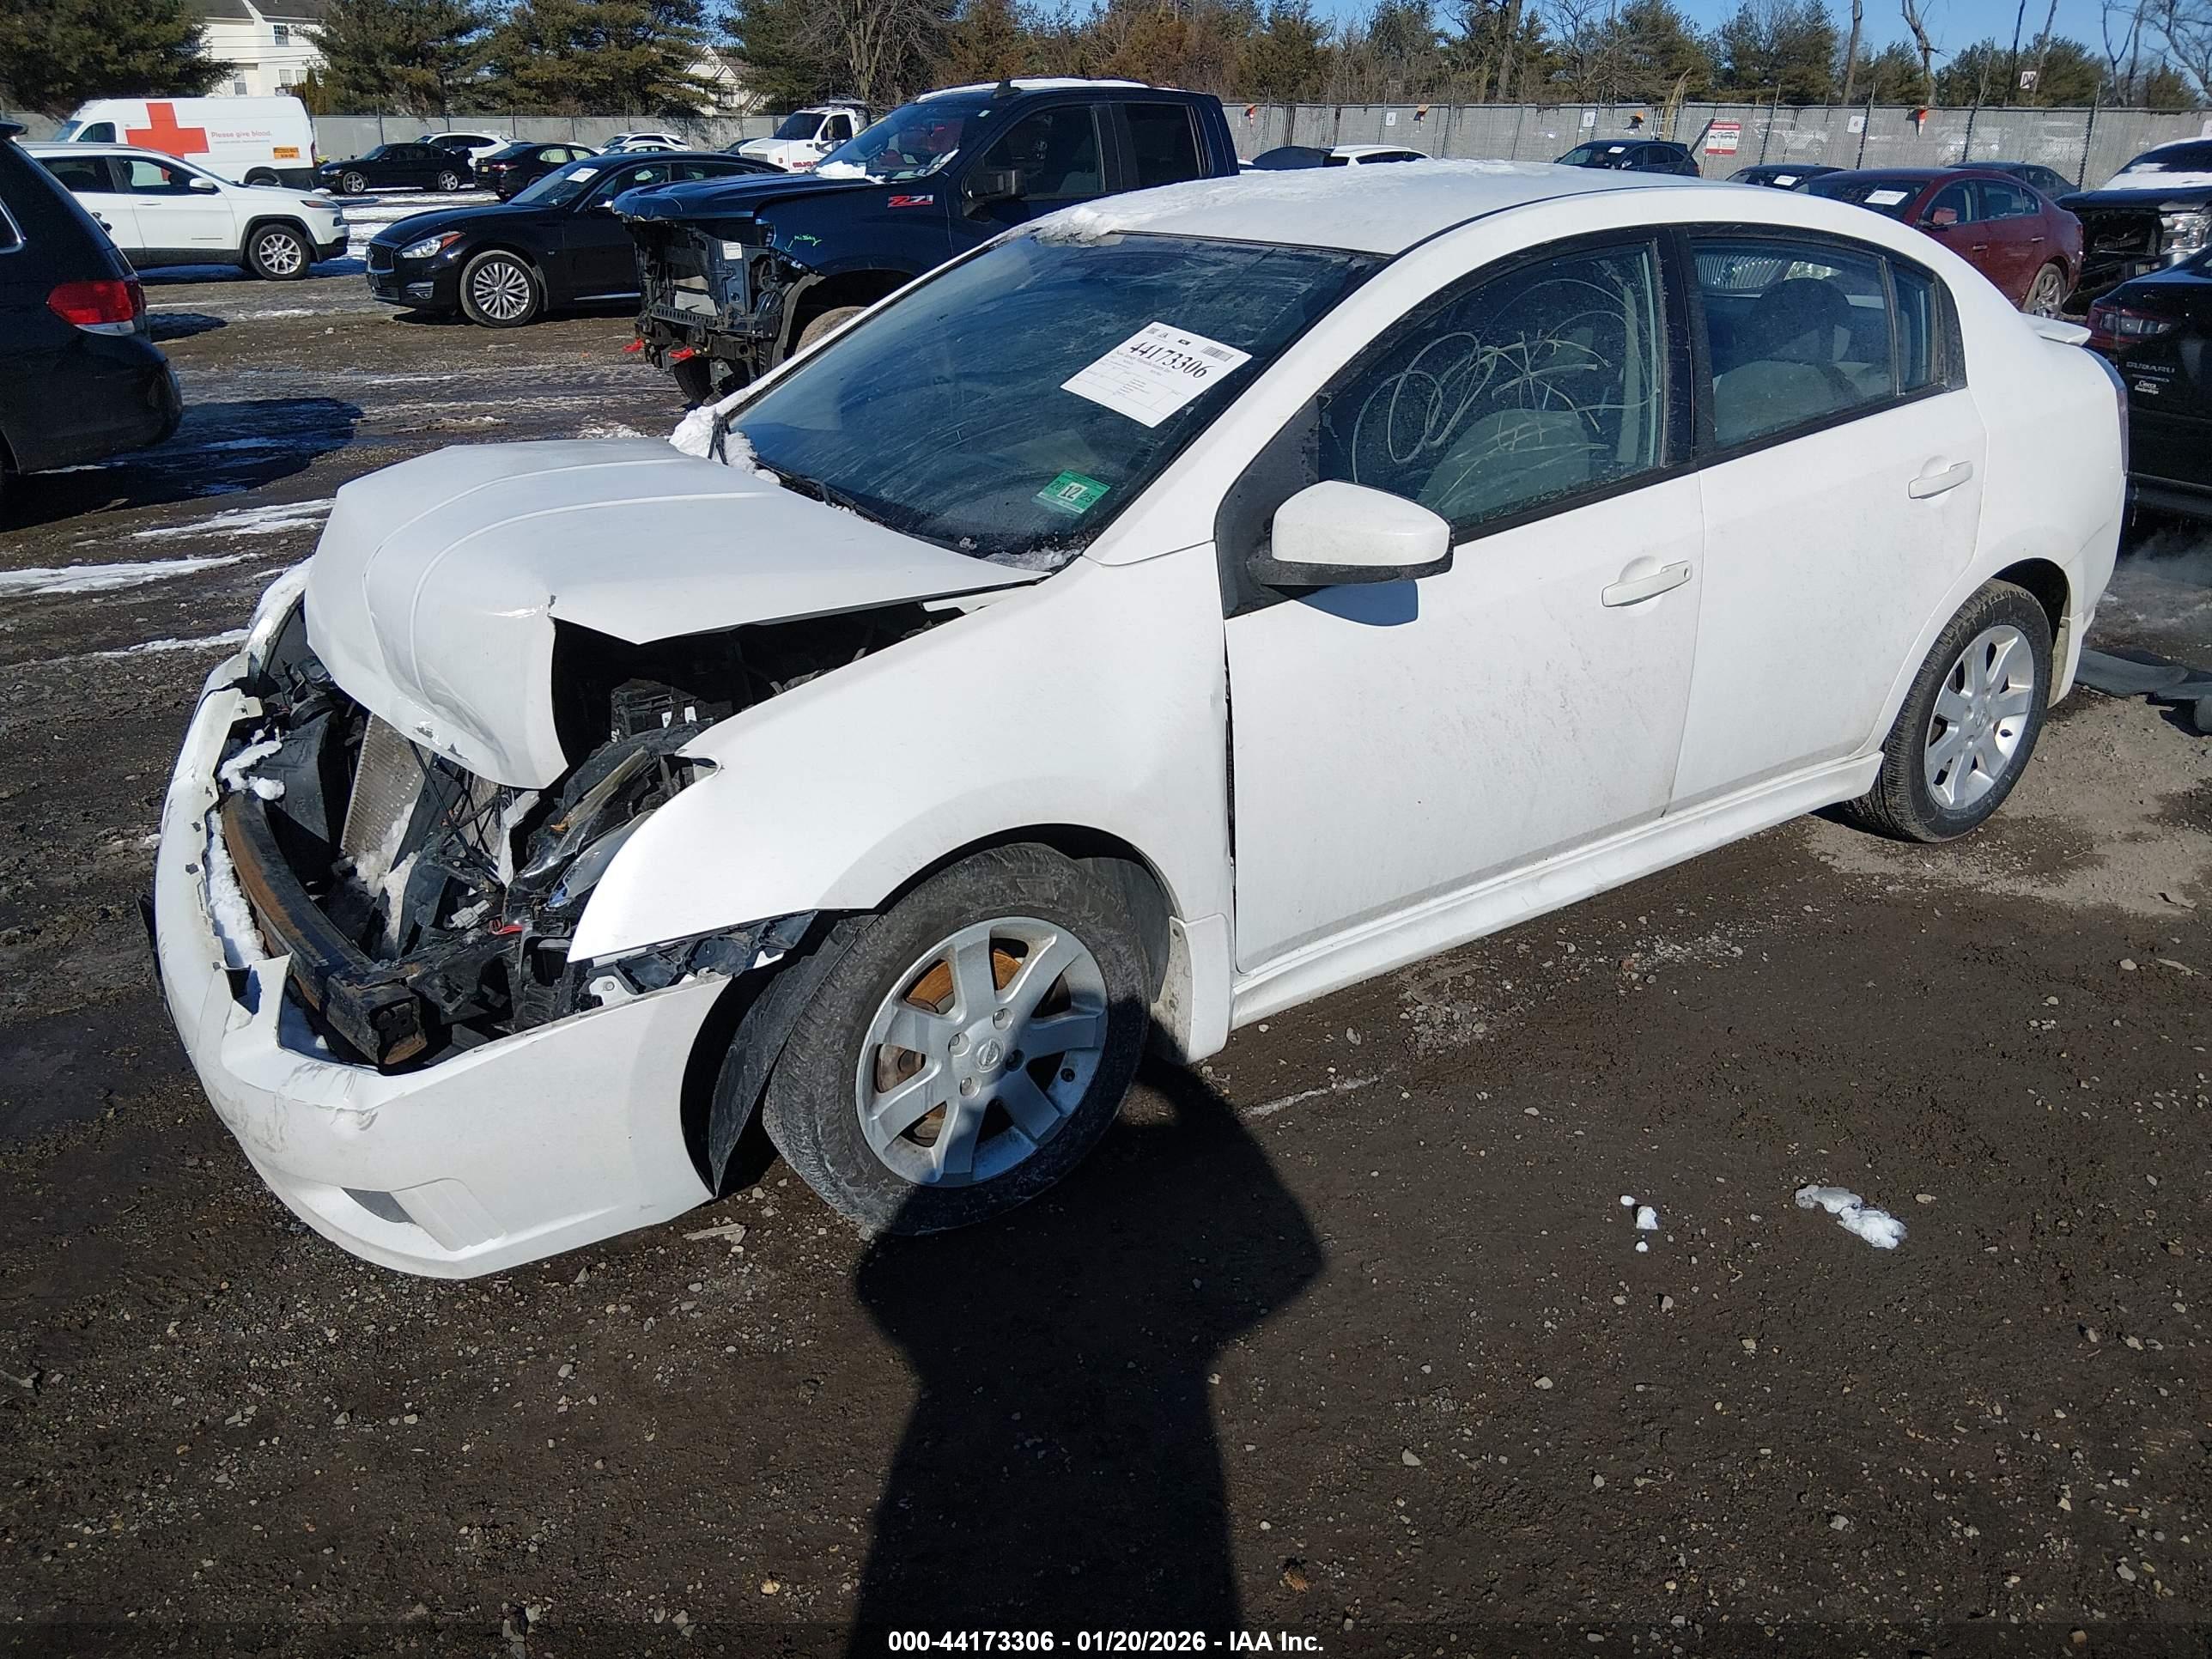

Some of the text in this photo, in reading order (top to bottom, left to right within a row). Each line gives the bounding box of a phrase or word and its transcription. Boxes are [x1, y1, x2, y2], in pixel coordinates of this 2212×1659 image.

[887, 195, 933, 208] Z71
[1129, 342, 1216, 379] 44173306
[2126, 362, 2175, 373] SUBARU
[1060, 485, 1082, 499] 12
[1079, 493, 1096, 502] 25
